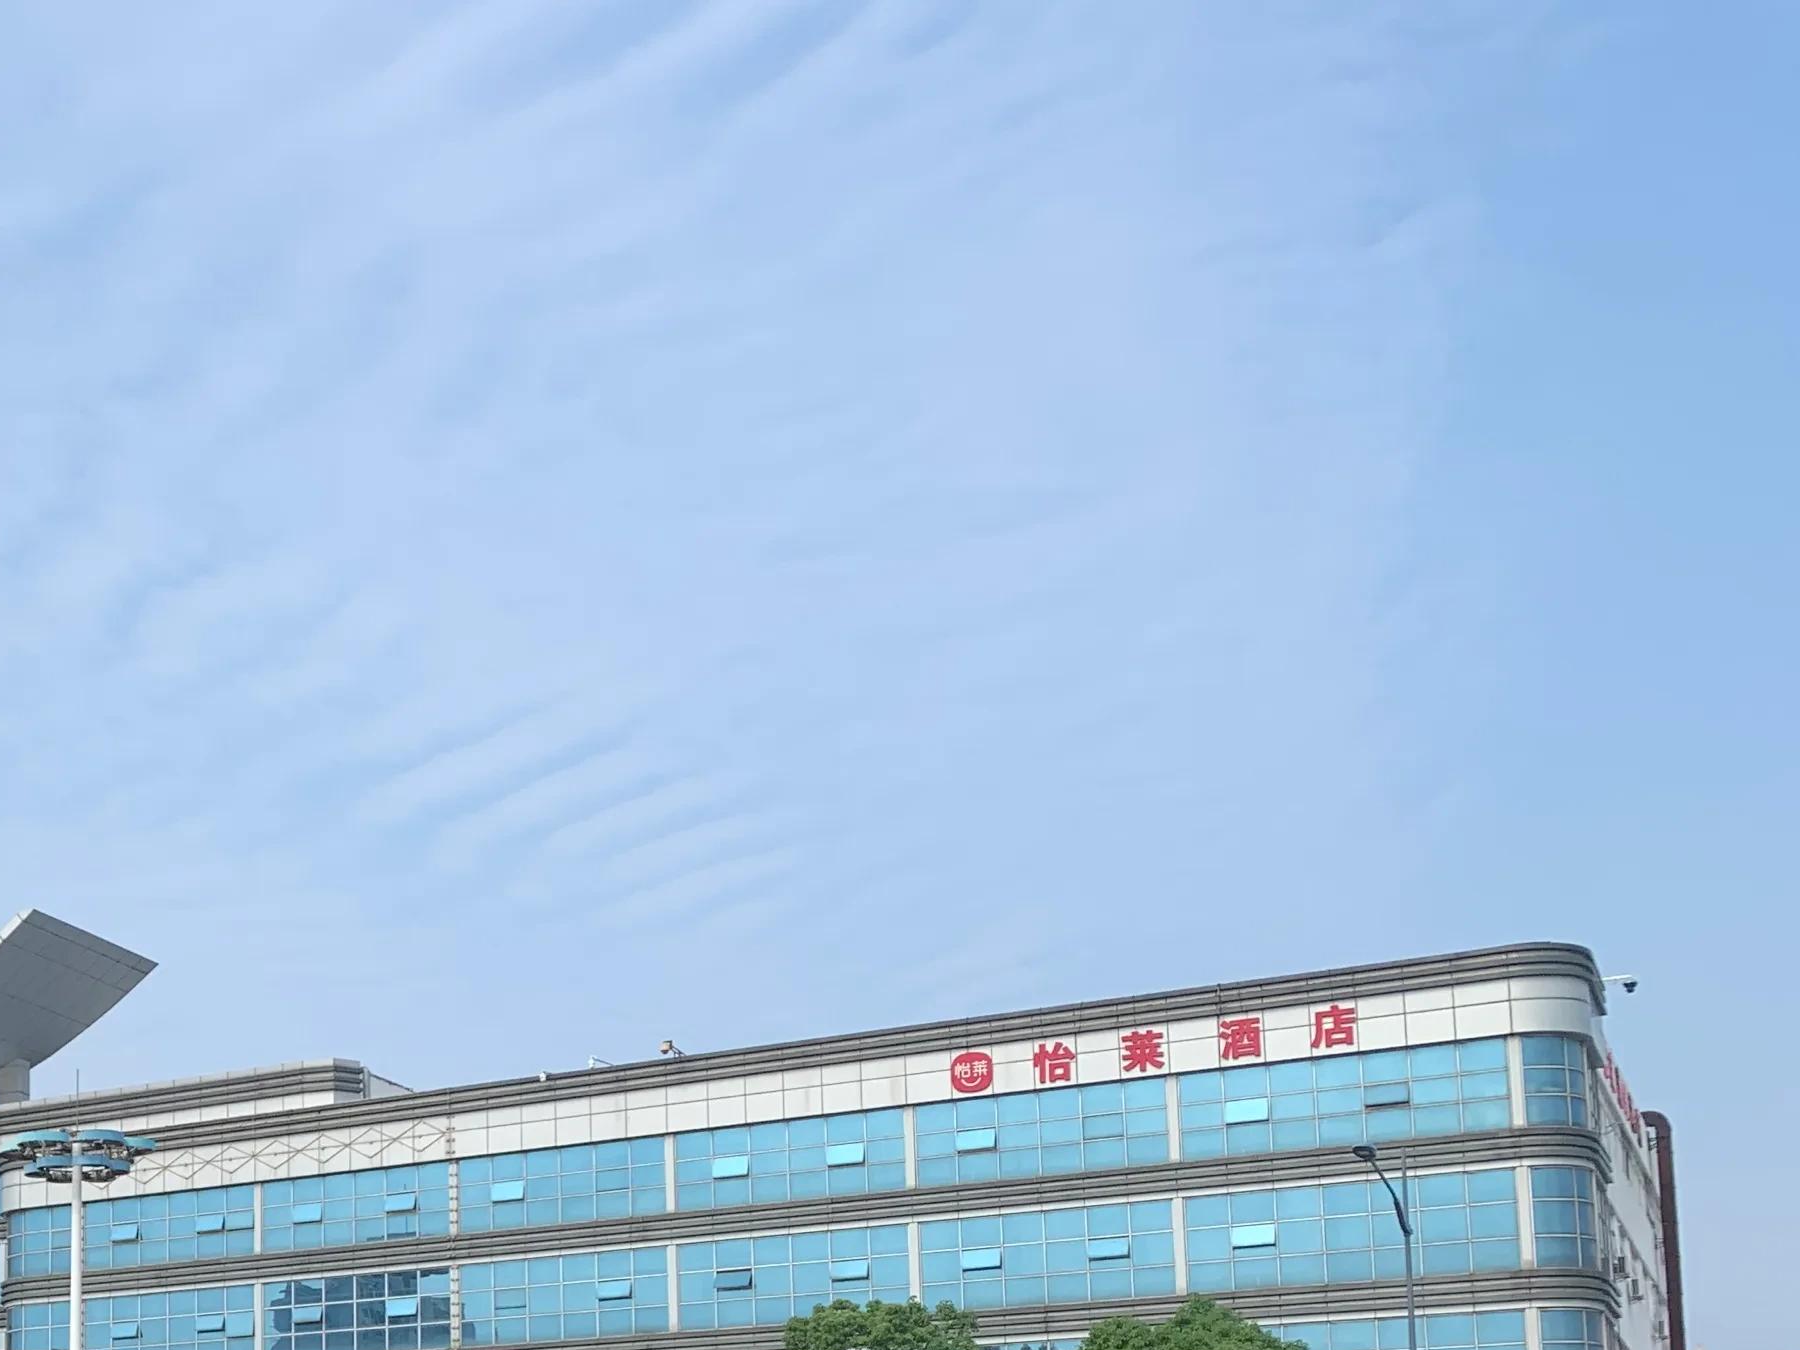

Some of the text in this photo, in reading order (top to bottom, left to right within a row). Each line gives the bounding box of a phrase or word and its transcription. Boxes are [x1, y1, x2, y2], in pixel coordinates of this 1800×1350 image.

[954, 1004, 1356, 1085] 怡莱 怡莱酒店
